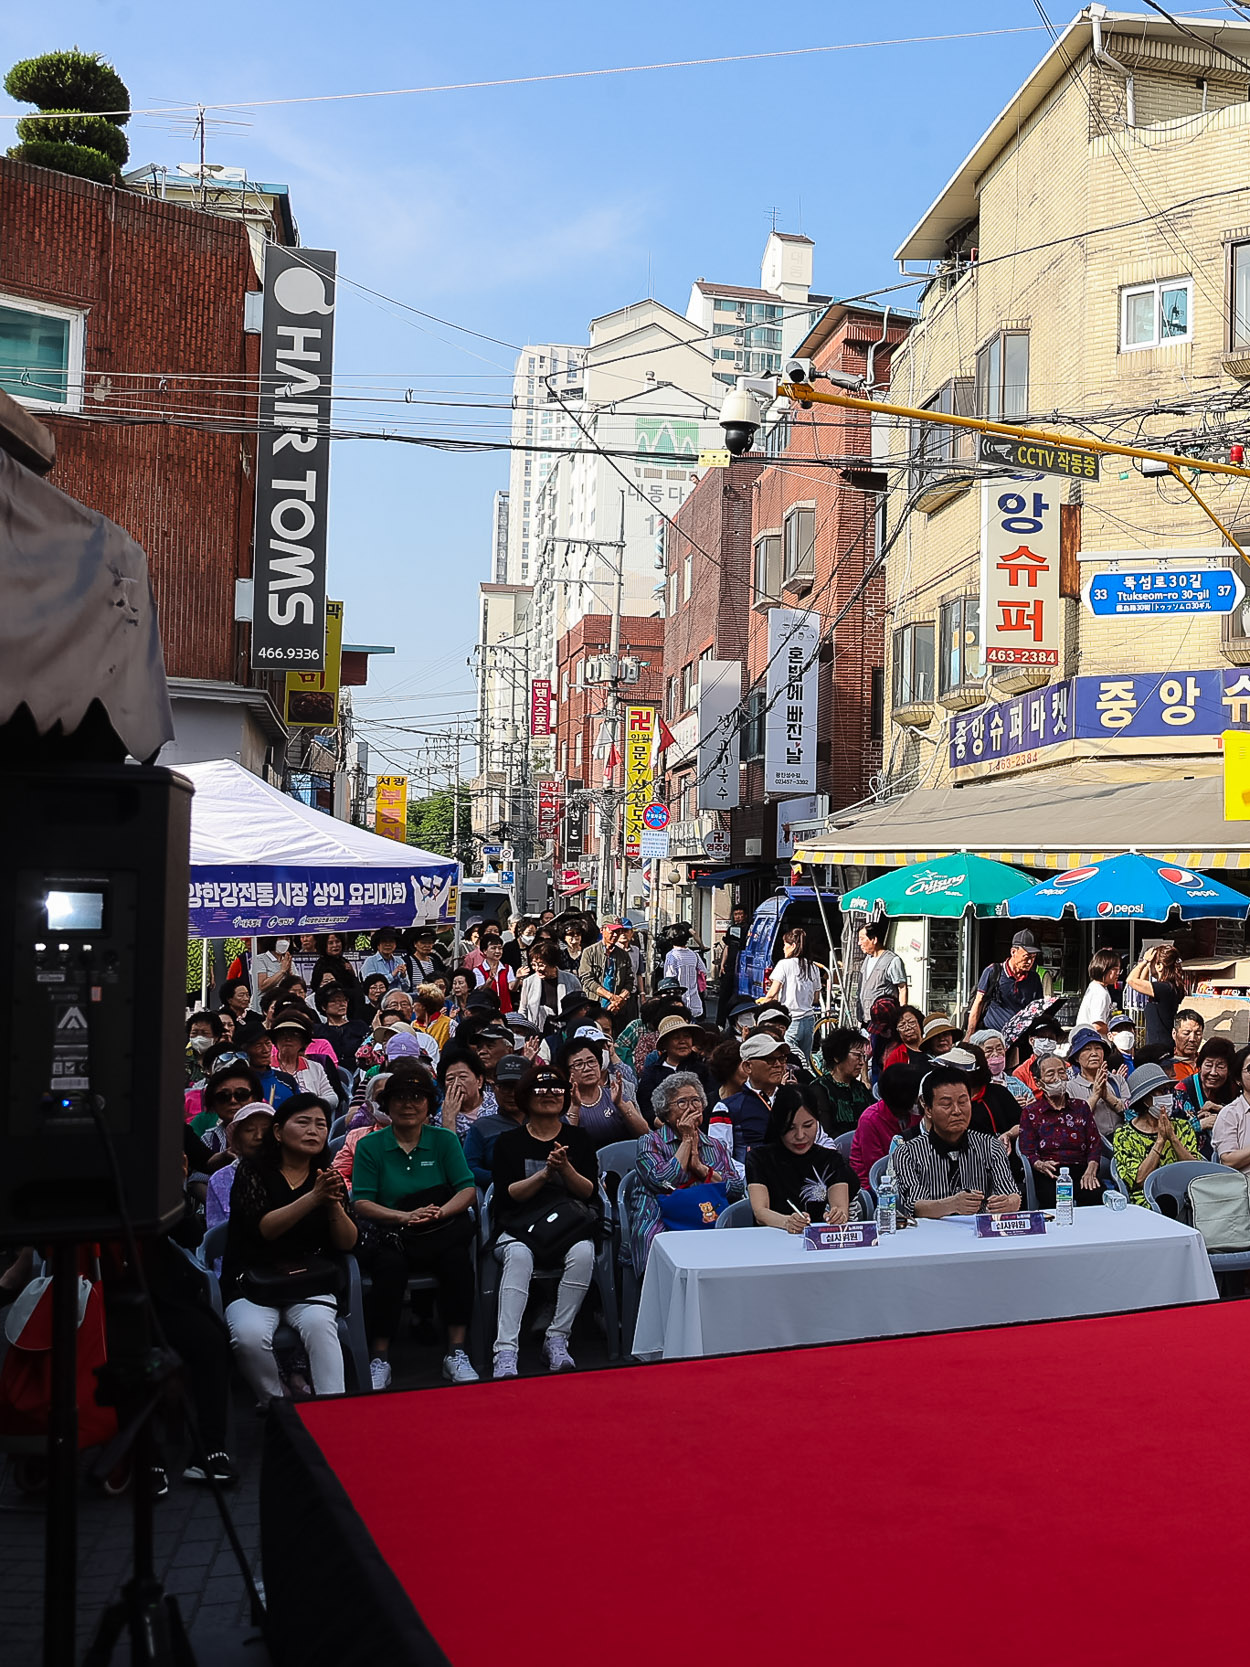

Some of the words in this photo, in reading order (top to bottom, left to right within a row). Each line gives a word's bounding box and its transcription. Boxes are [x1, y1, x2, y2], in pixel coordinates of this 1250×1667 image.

[272, 326, 322, 456] HAIR
[1017, 446, 1055, 469] CCTV
[1057, 451, 1096, 477] 작동중
[268, 470, 316, 627] TOMS
[996, 474, 1050, 643] 앙슈퍼
[1122, 573, 1202, 591] 뚝섬로30길
[1093, 589, 1108, 600] 33
[1116, 590, 1179, 602] Ttukseom-ro
[1181, 589, 1210, 601] 30-gil
[1217, 585, 1232, 596] 37
[258, 647, 320, 660] 466.9336
[988, 650, 1056, 664] 463-2384
[786, 706, 804, 741] 빠진
[954, 687, 1068, 760] 중앙슈퍼마켓
[786, 748, 804, 765] 날
[378, 777, 405, 787] 서광
[312, 882, 345, 908] 상인
[349, 881, 407, 906] 요리대회
[1114, 903, 1144, 915] pepsi
[995, 1220, 1026, 1230] 심사위원
[825, 1232, 859, 1243] 심사위원
